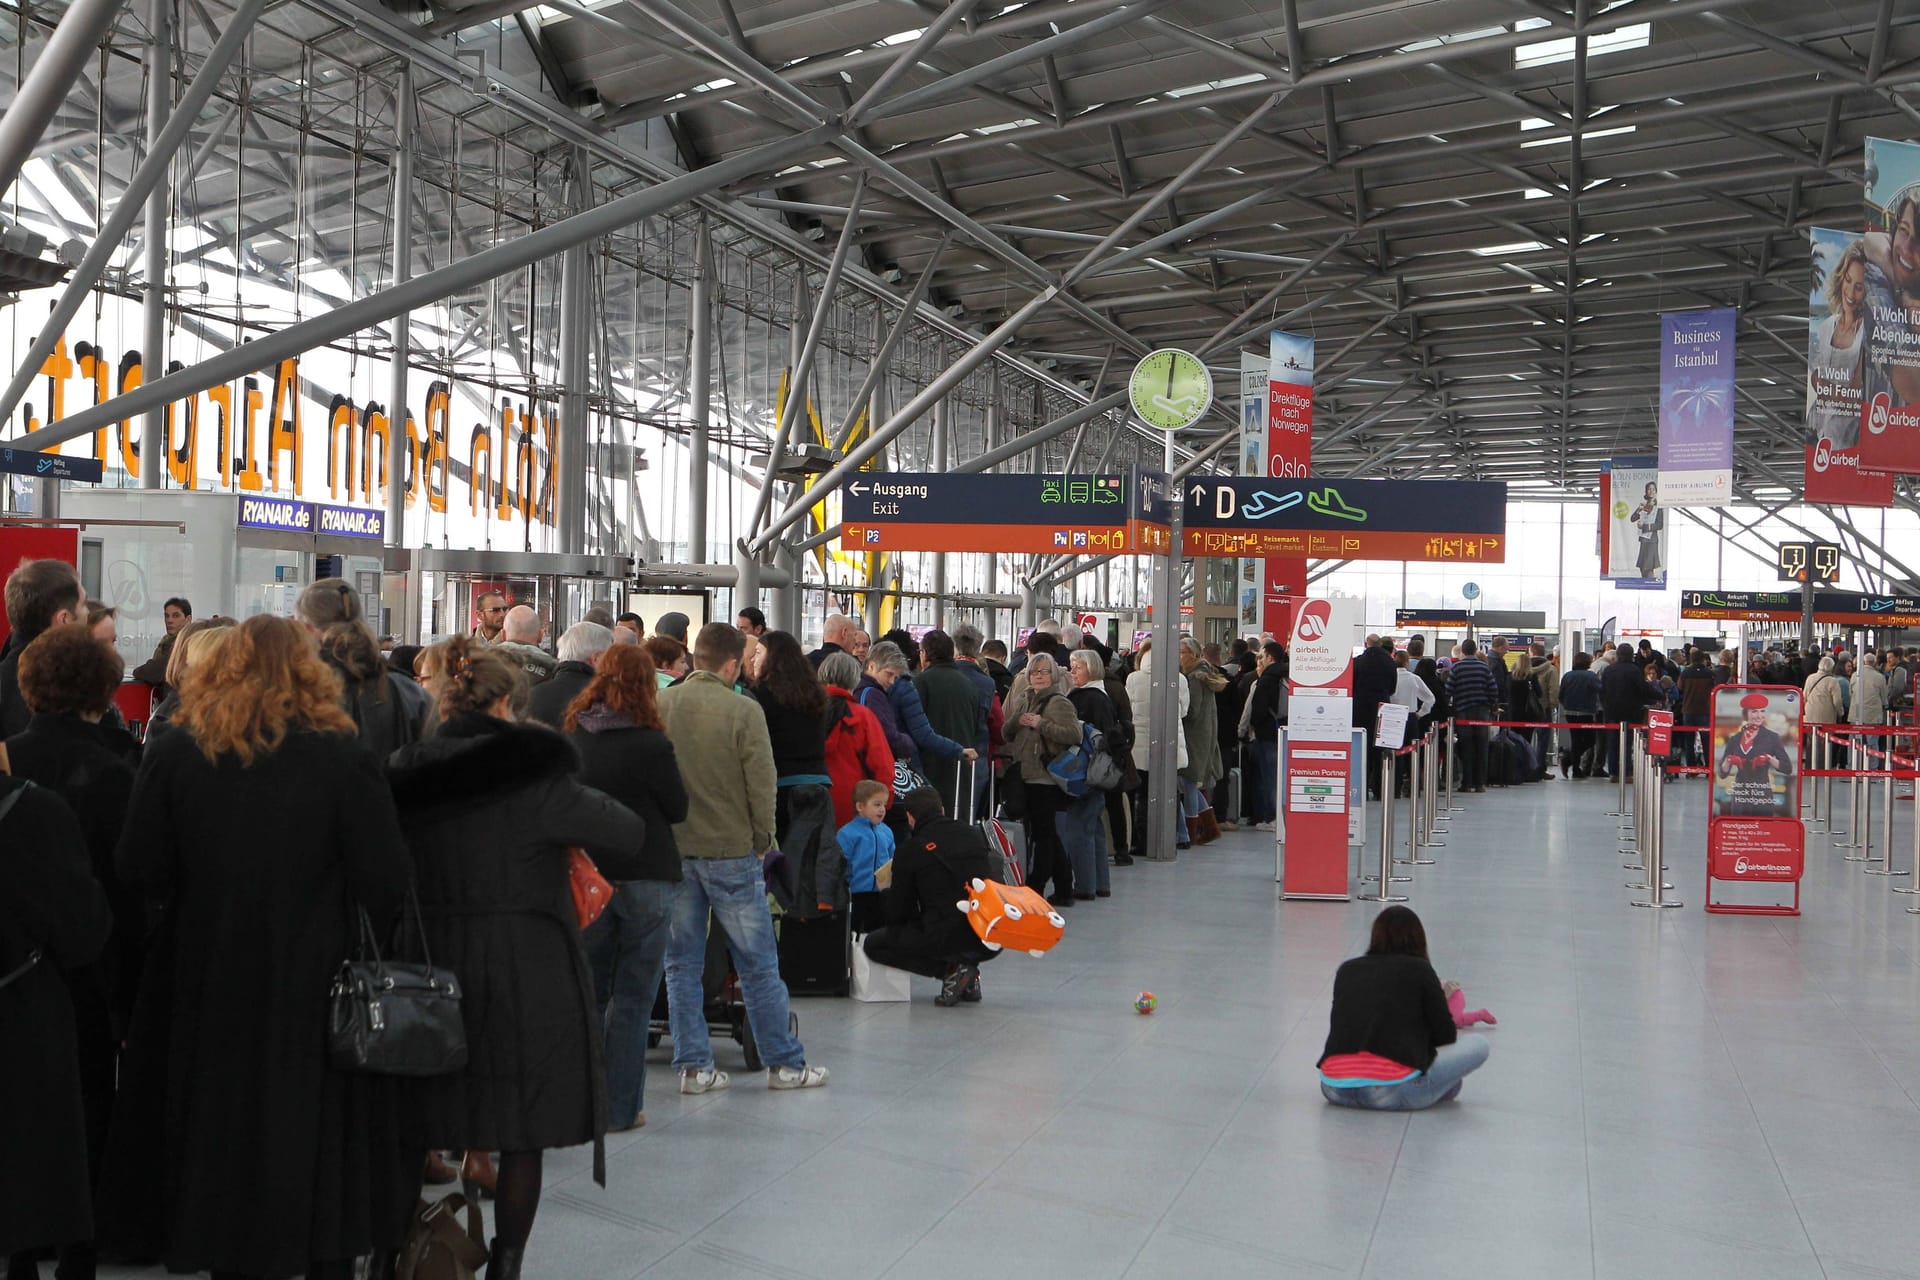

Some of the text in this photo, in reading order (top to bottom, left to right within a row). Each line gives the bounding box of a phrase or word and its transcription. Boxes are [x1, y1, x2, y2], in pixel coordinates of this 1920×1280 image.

[1674, 330, 1721, 345] Business
[1674, 350, 1718, 368] Istanbul
[1816, 382, 1832, 396] bei
[1271, 391, 1310, 410] Direktflüge
[1281, 408, 1300, 419] nach
[1272, 417, 1308, 434] Norwegen
[1270, 454, 1307, 478] Oslo
[872, 482, 928, 498] Ausgang
[1042, 479, 1060, 488] Taxi
[872, 502, 900, 515] Exit
[1216, 486, 1236, 519] D
[242, 500, 310, 528] RYANAIR.de
[321, 509, 380, 534] RYANAIR.de
[1692, 592, 1701, 606] D
[1860, 598, 1868, 611] D
[1296, 646, 1328, 654] airberlin
